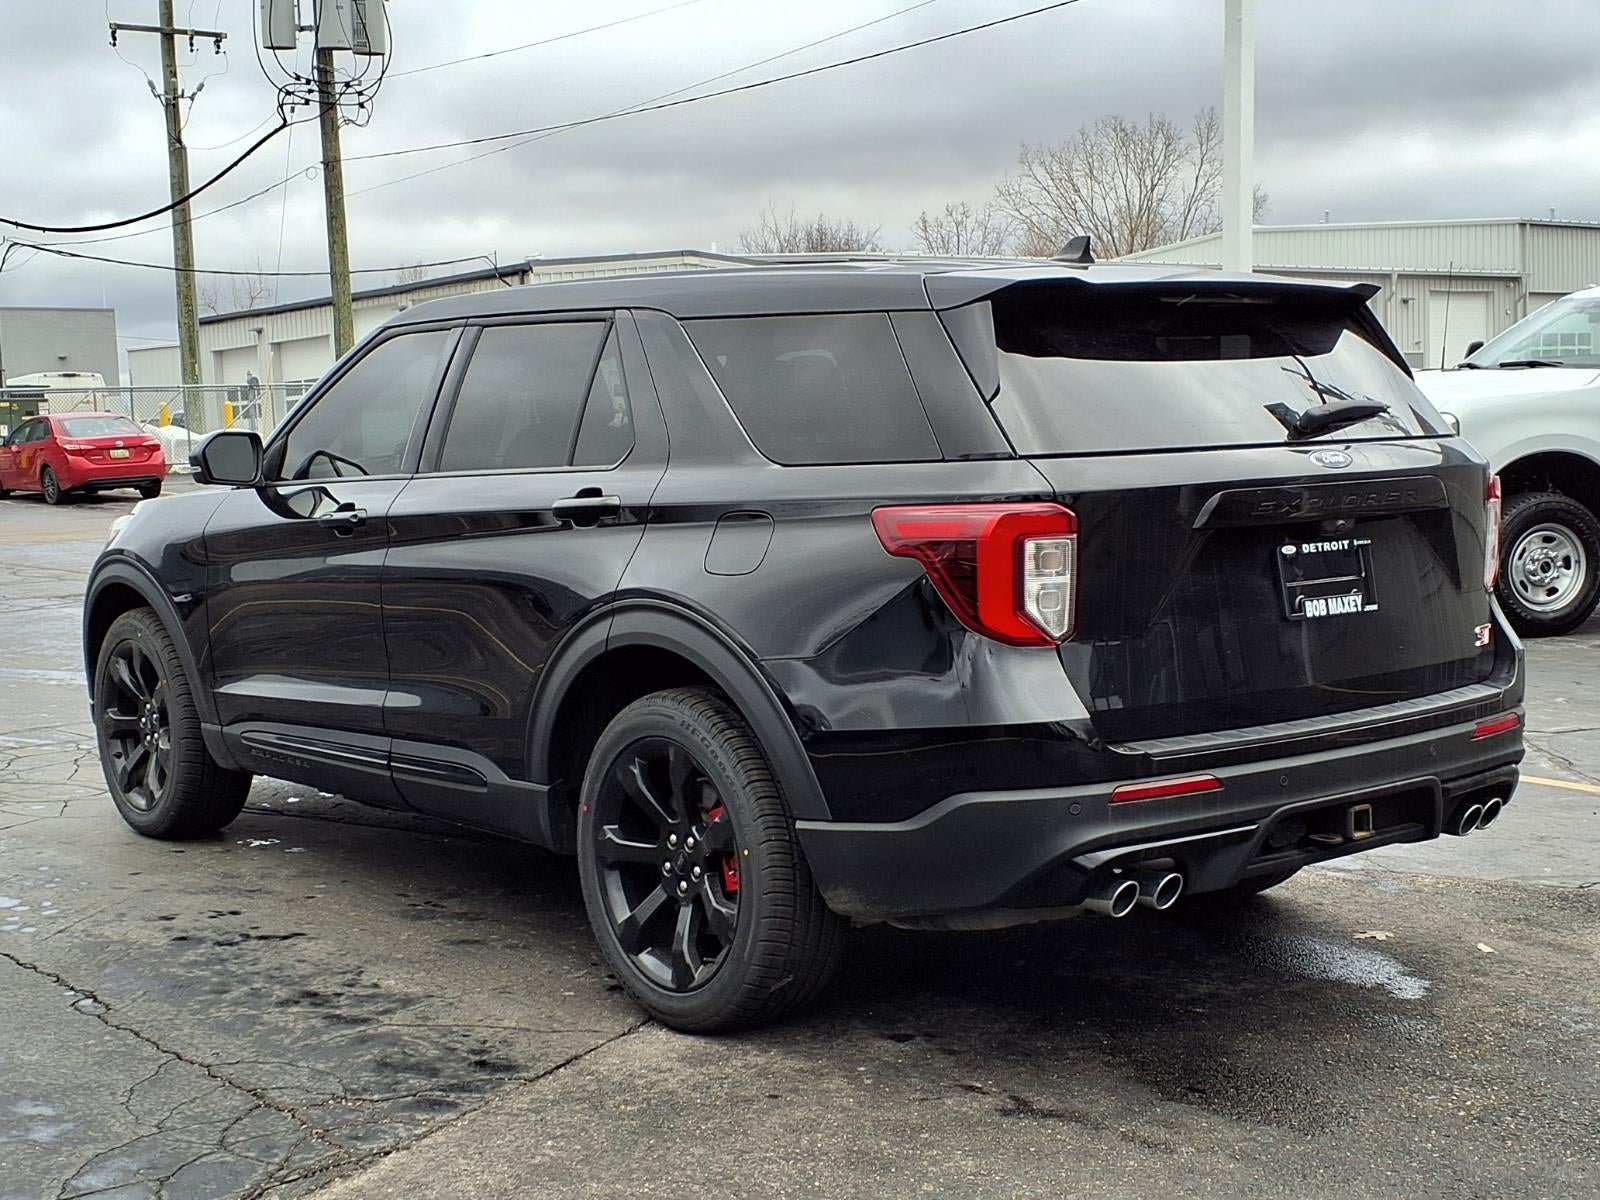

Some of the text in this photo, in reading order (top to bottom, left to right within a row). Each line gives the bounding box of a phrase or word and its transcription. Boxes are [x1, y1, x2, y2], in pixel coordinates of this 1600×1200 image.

[1251, 489, 1417, 515] EXPLORER
[1302, 540, 1350, 553] DETROIT
[1305, 598, 1328, 617] BOB
[1328, 594, 1363, 615] MAXEY
